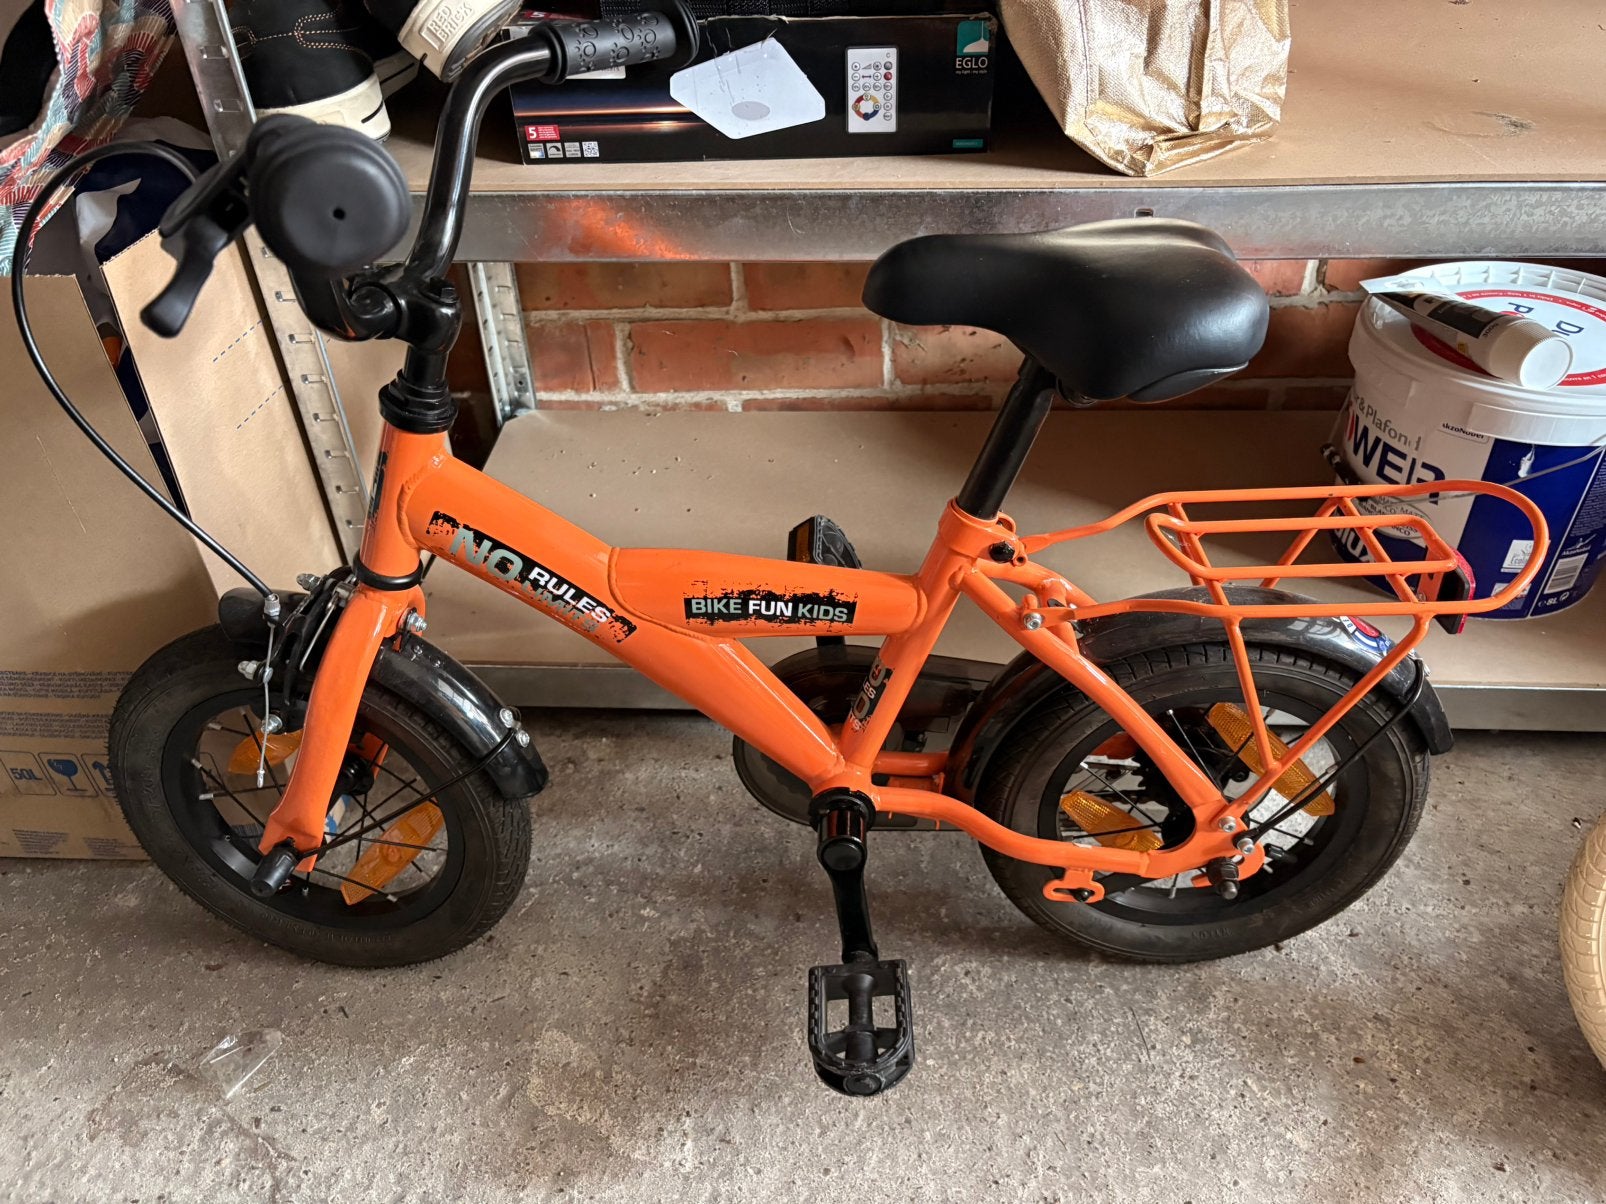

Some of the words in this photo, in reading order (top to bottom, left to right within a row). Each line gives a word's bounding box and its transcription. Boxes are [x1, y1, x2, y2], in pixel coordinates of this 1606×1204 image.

[427, 5, 452, 34] RED
[438, 2, 473, 42] BRICK
[955, 57, 988, 69] EGLO
[528, 127, 537, 139] 5
[450, 527, 524, 583] NO
[528, 566, 611, 623] RULES
[691, 598, 742, 613] BIKE
[748, 600, 793, 616] FUN
[797, 603, 848, 621] KIDS
[10, 767, 43, 780] 50L
